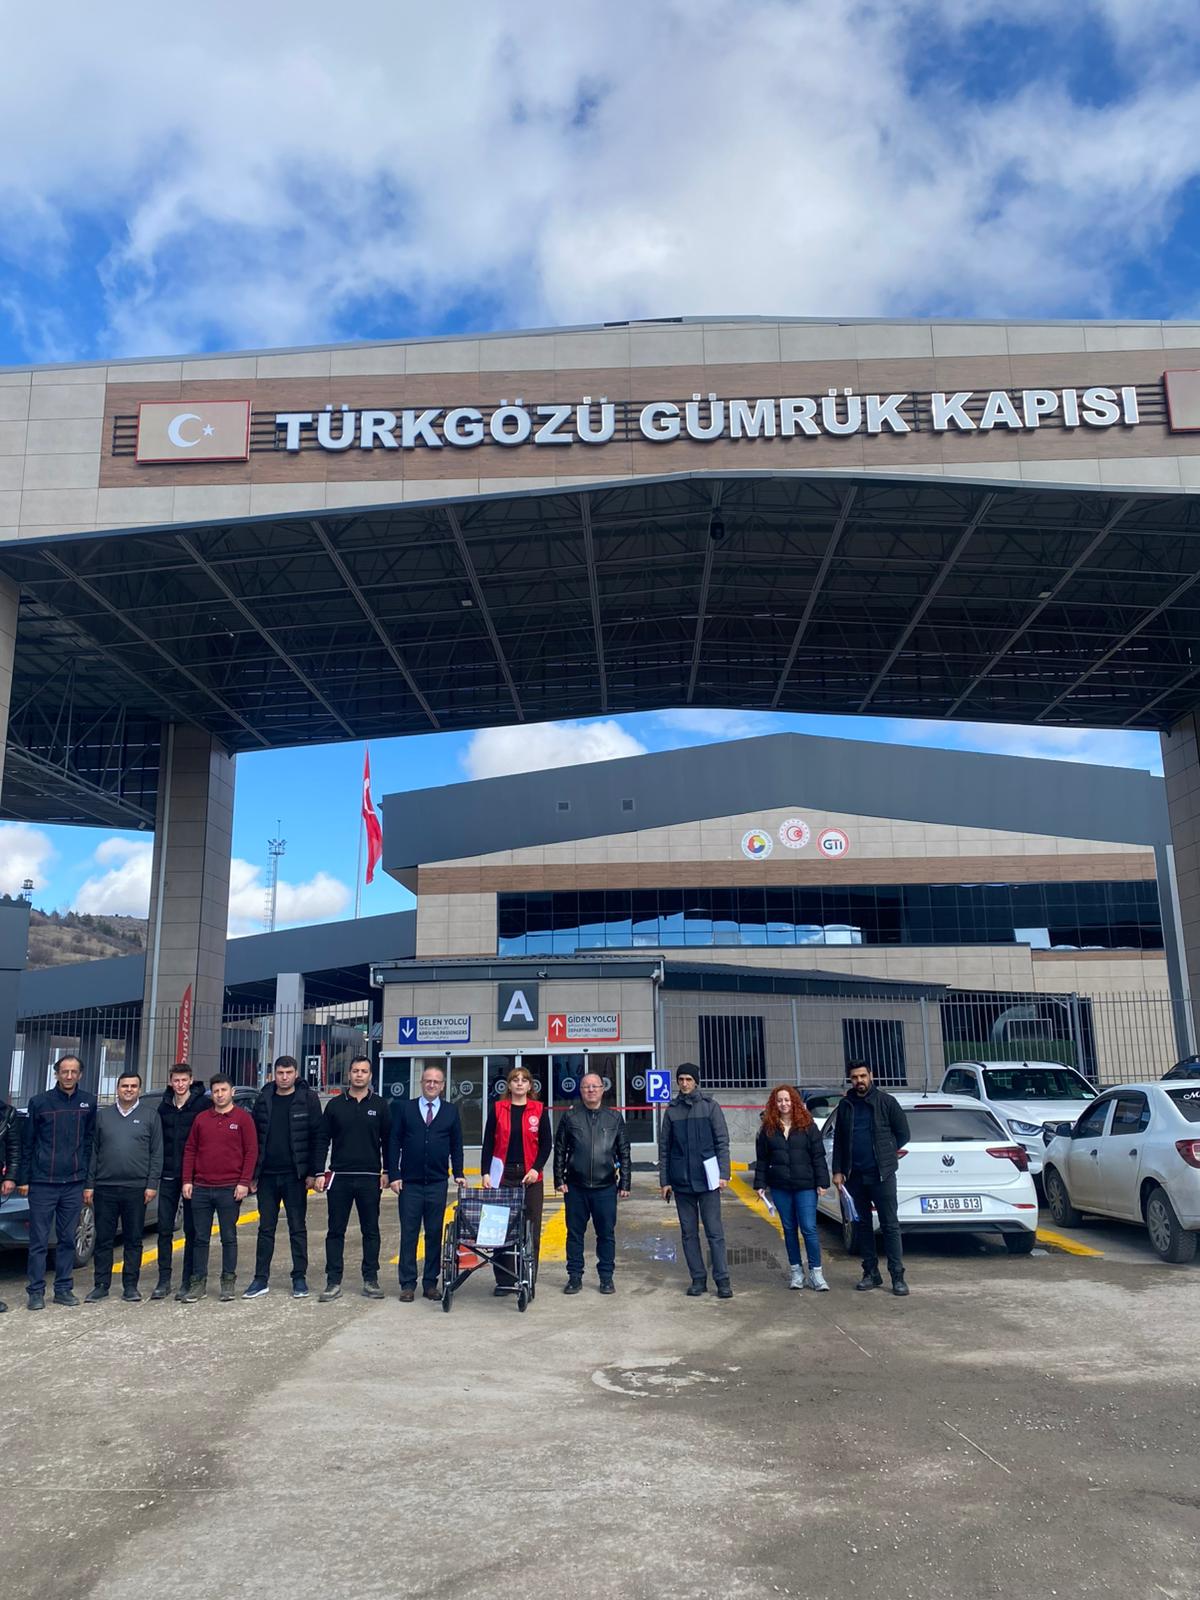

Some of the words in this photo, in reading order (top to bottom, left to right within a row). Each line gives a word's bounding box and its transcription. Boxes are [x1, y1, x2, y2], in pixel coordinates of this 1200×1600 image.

[275, 396, 616, 453] TÜRKGÖZÜ
[639, 387, 912, 443] GÜMRÜK
[932, 386, 1141, 431] KAPISI
[503, 990, 534, 1022] A
[418, 1018, 443, 1026] GELEN
[443, 1018, 468, 1026] YOLCU
[567, 1014, 591, 1023] GİDEN
[592, 1015, 617, 1023] YOLCU
[650, 1074, 663, 1098] P
[927, 1199, 939, 1209] 43
[943, 1199, 960, 1209] AGB
[963, 1198, 979, 1208] 613
